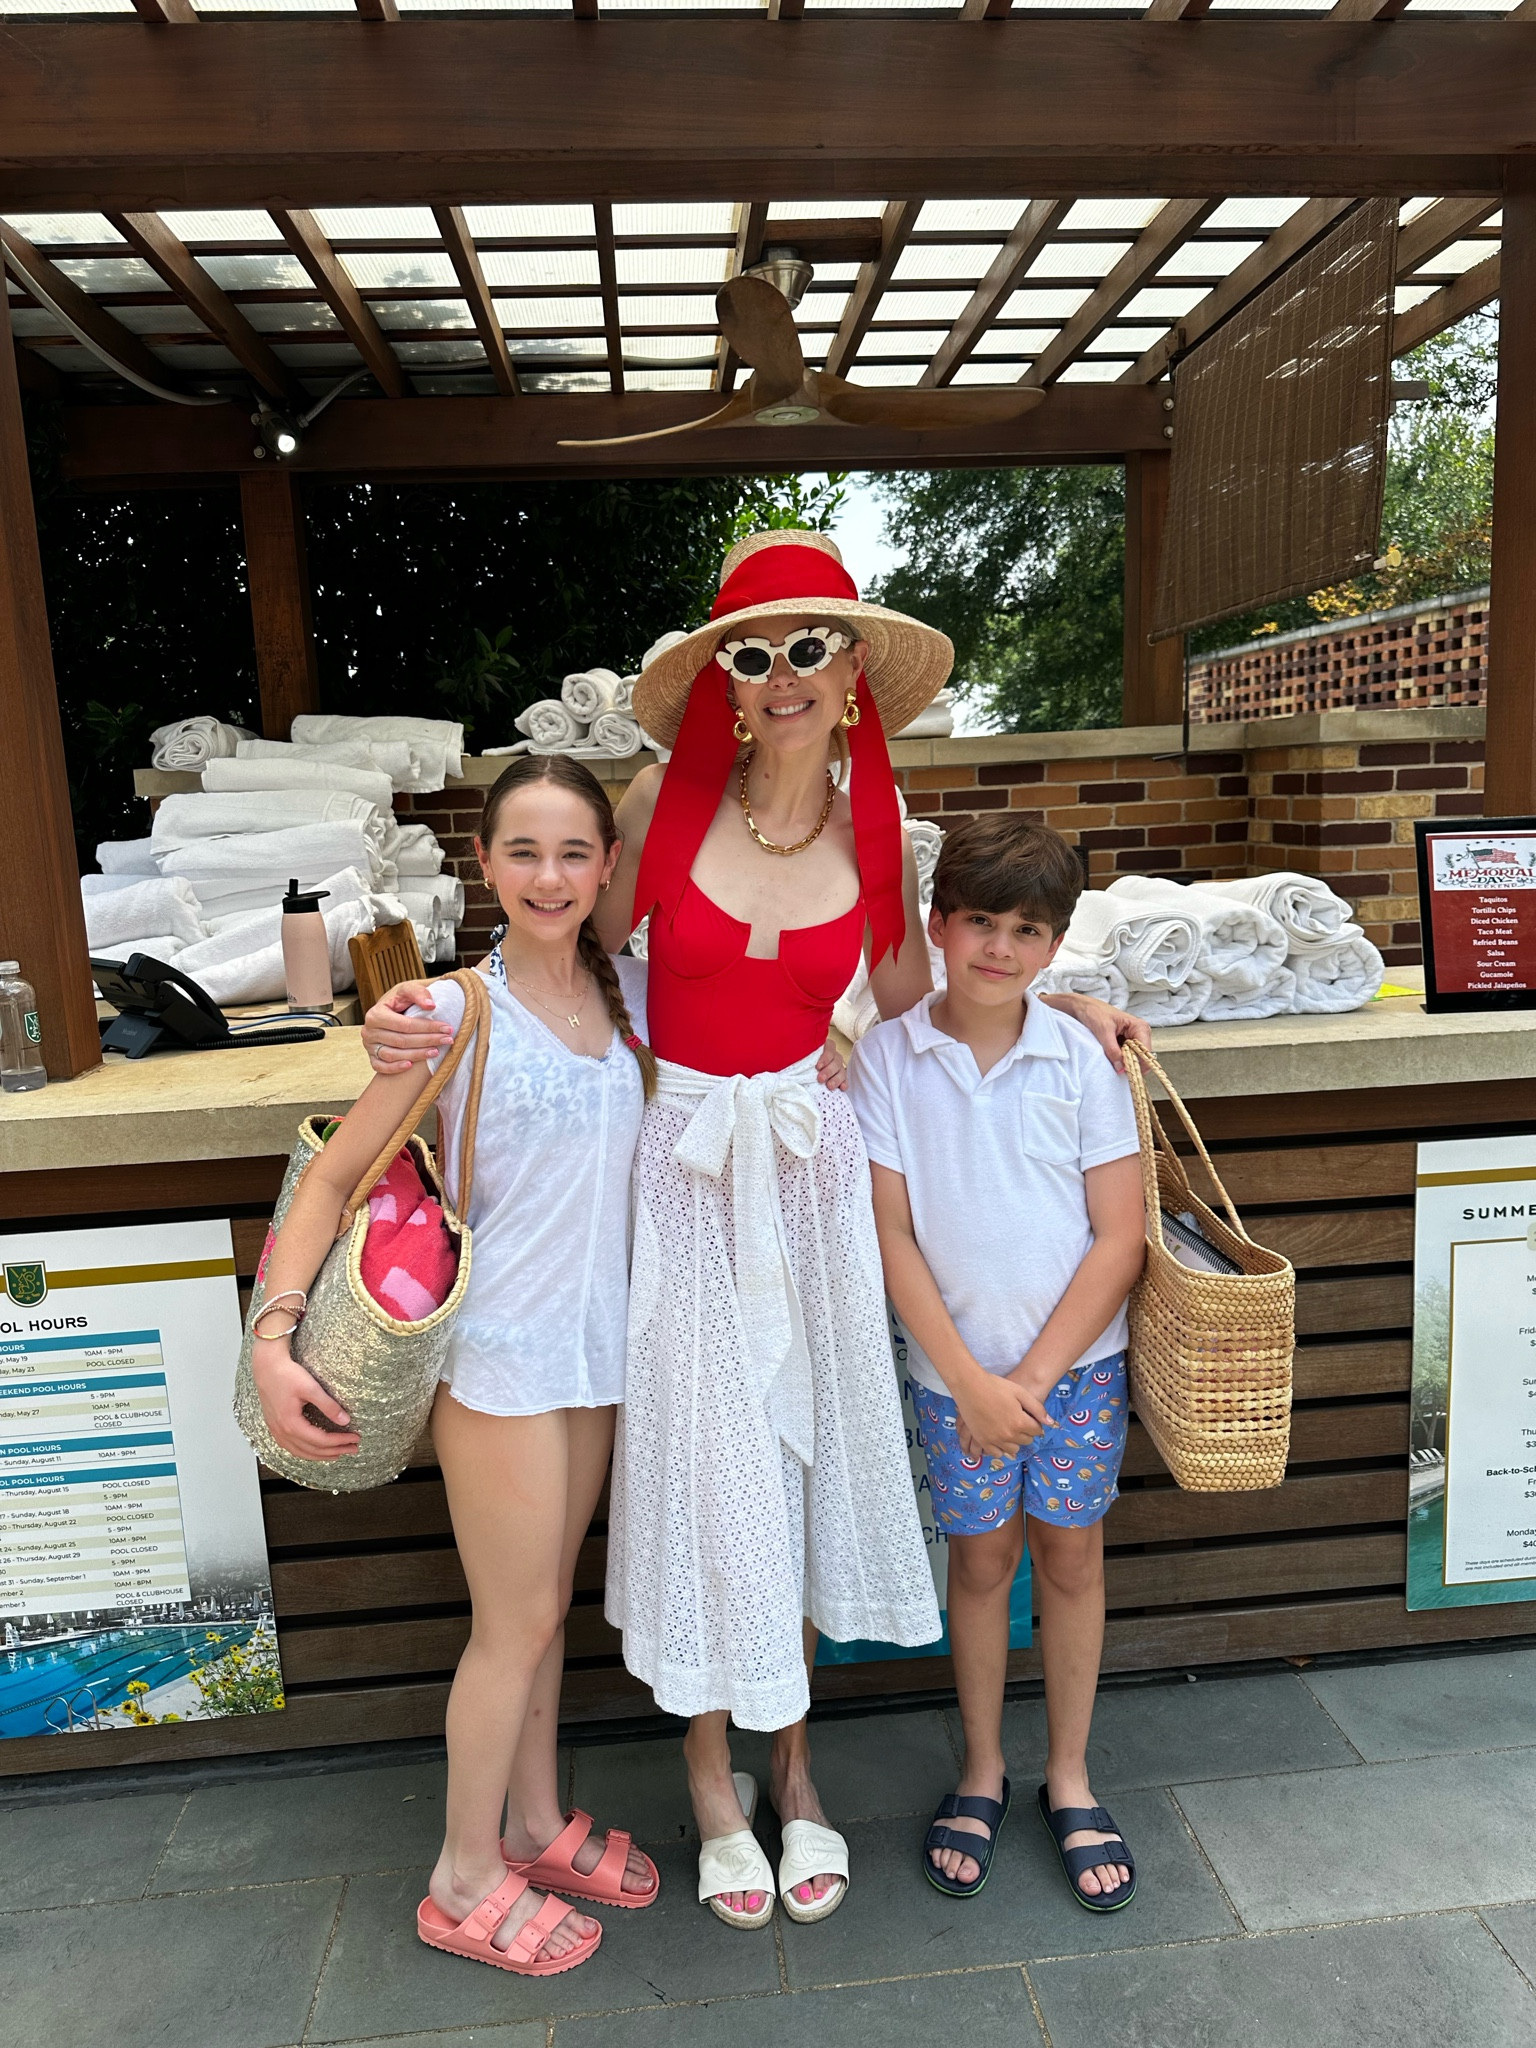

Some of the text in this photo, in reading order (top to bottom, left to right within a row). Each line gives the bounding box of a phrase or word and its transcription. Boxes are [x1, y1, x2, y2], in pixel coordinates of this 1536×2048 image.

[1477, 876, 1506, 885] DAY
[1479, 896, 1508, 904] Taquitos
[1497, 906, 1517, 915] Chips
[1471, 917, 1519, 925] Diced Chicken
[1487, 949, 1505, 957] Salsa
[1477, 960, 1493, 968] Sour
[1480, 971, 1514, 979] Gucamole
[1493, 981, 1527, 990] Jalapeños
[29, 1316, 88, 1332] HOURS
[84, 1349, 103, 1357] 10AM
[107, 1358, 135, 1366] CLOSED
[12, 1366, 26, 1374] May
[27, 1365, 36, 1373] 23
[33, 1385, 56, 1394] POOL
[58, 1382, 87, 1391] HOURS
[120, 1410, 162, 1419] CLUBHOUSE
[94, 1420, 123, 1428] CLOSED
[8, 1447, 31, 1455] POOL
[33, 1444, 62, 1453] HOURS
[12, 1478, 35, 1486] POOL
[37, 1475, 65, 1484] HOURS
[122, 1479, 151, 1488] CLOSED
[6, 1489, 38, 1497] Thursday,
[38, 1487, 62, 1495] August
[11, 1511, 38, 1519] Sunday,
[38, 1509, 62, 1517] August
[126, 1512, 155, 1520] CLOSED
[44, 1520, 68, 1528] August
[17, 1544, 43, 1552] Sunday,
[44, 1542, 68, 1550] August
[131, 1545, 159, 1553] CLOSED
[16, 1555, 47, 1563] Thursday,
[20, 1577, 46, 1585] Sunday,
[46, 1574, 82, 1583] September
[142, 1588, 184, 1597] CLUBHOUSE
[117, 1598, 144, 1606] CLOSED
